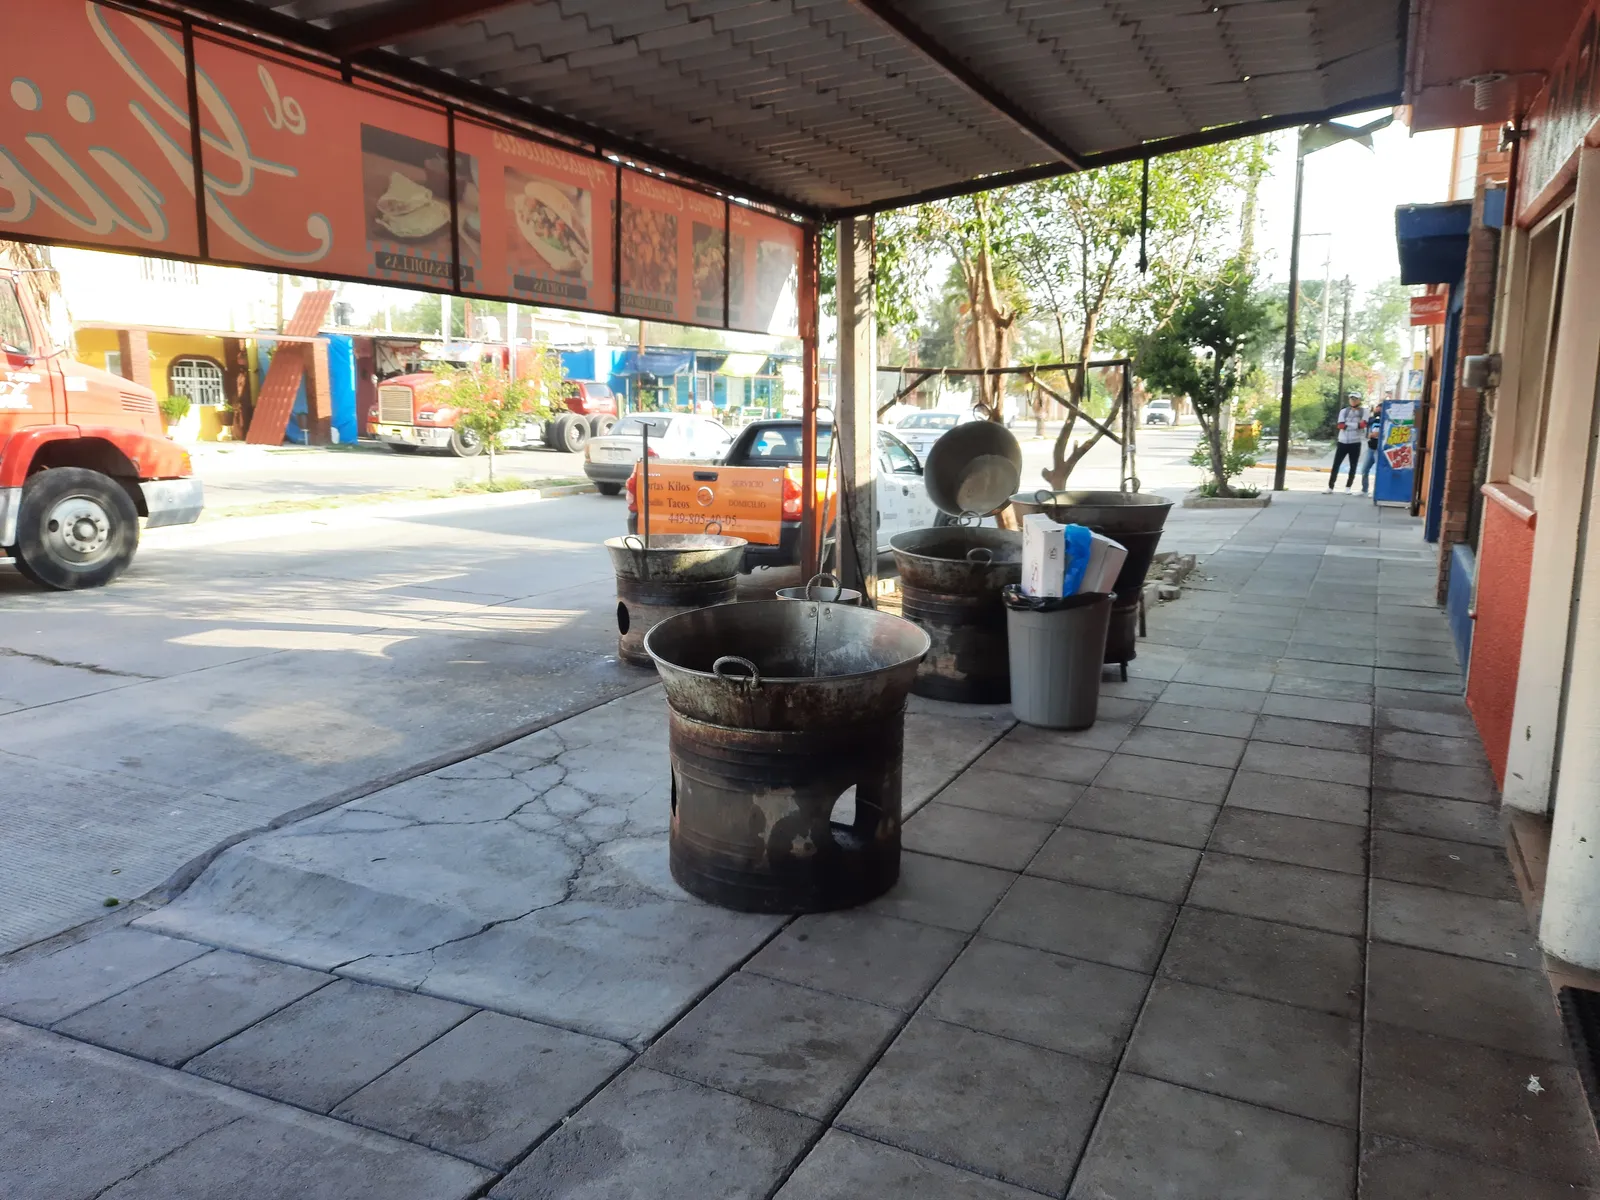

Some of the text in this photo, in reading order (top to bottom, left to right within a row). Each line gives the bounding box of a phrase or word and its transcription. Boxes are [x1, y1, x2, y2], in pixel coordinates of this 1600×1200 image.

[668, 480, 690, 492] Kilos
[731, 479, 764, 488] SERVICIO
[667, 497, 690, 509] Tacos
[728, 499, 767, 509] DOMICILIO
